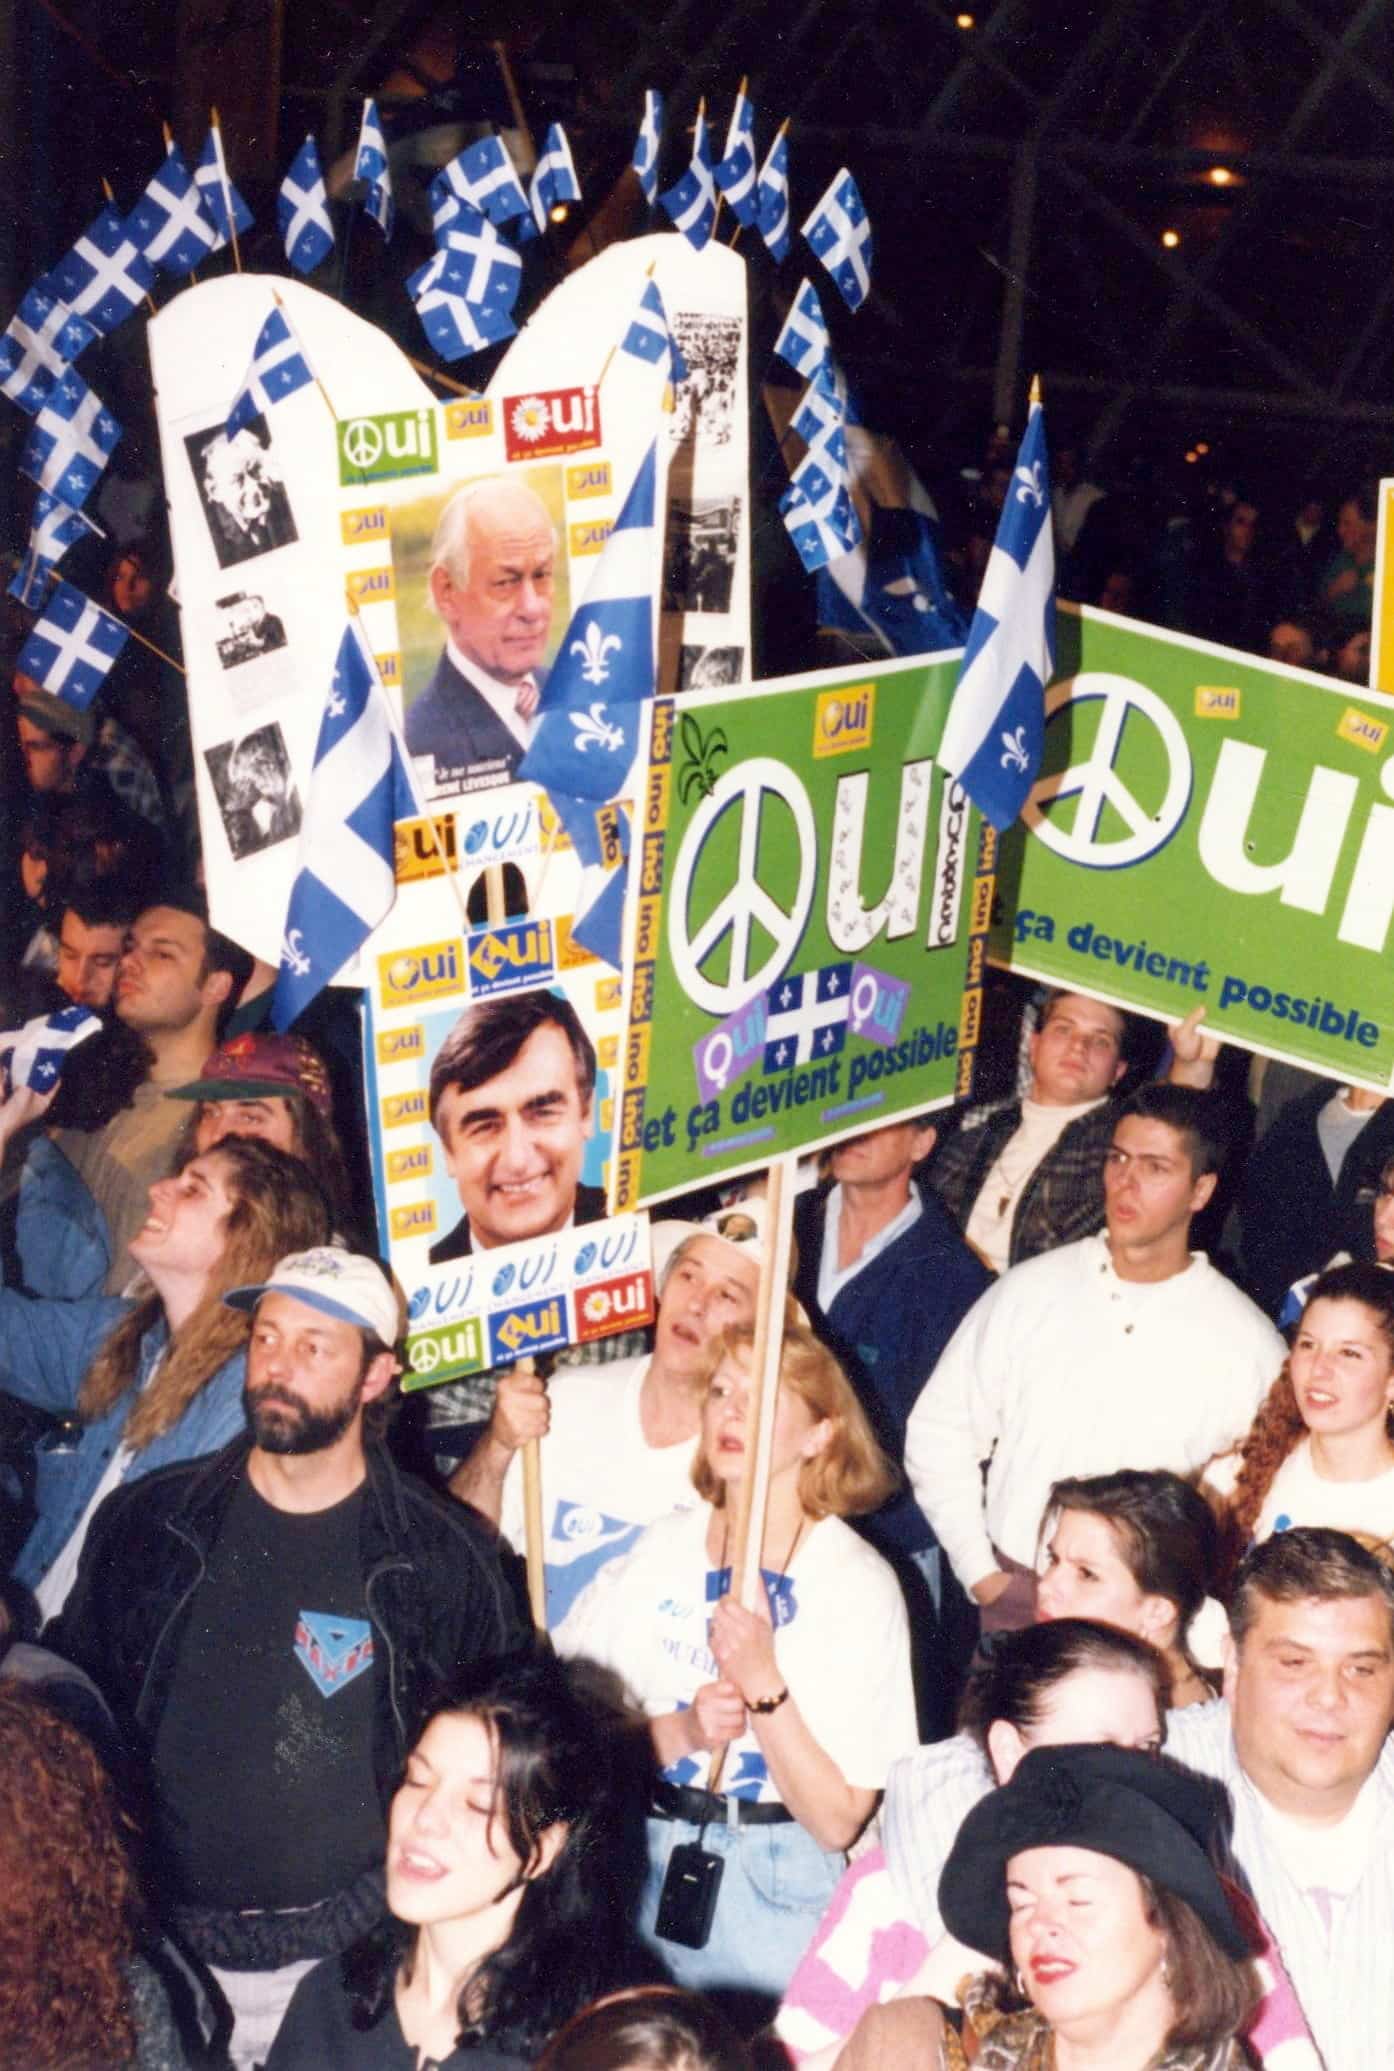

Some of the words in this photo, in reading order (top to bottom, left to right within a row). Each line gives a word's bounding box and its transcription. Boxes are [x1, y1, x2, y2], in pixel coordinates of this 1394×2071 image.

[1015, 909, 1055, 944] ça
[1066, 923, 1211, 993] devient
[1218, 974, 1380, 1049] possible
[642, 1105, 676, 1151] et
[687, 1100, 720, 1153] ça
[731, 1058, 842, 1124] devient
[848, 1021, 958, 1100] possible
